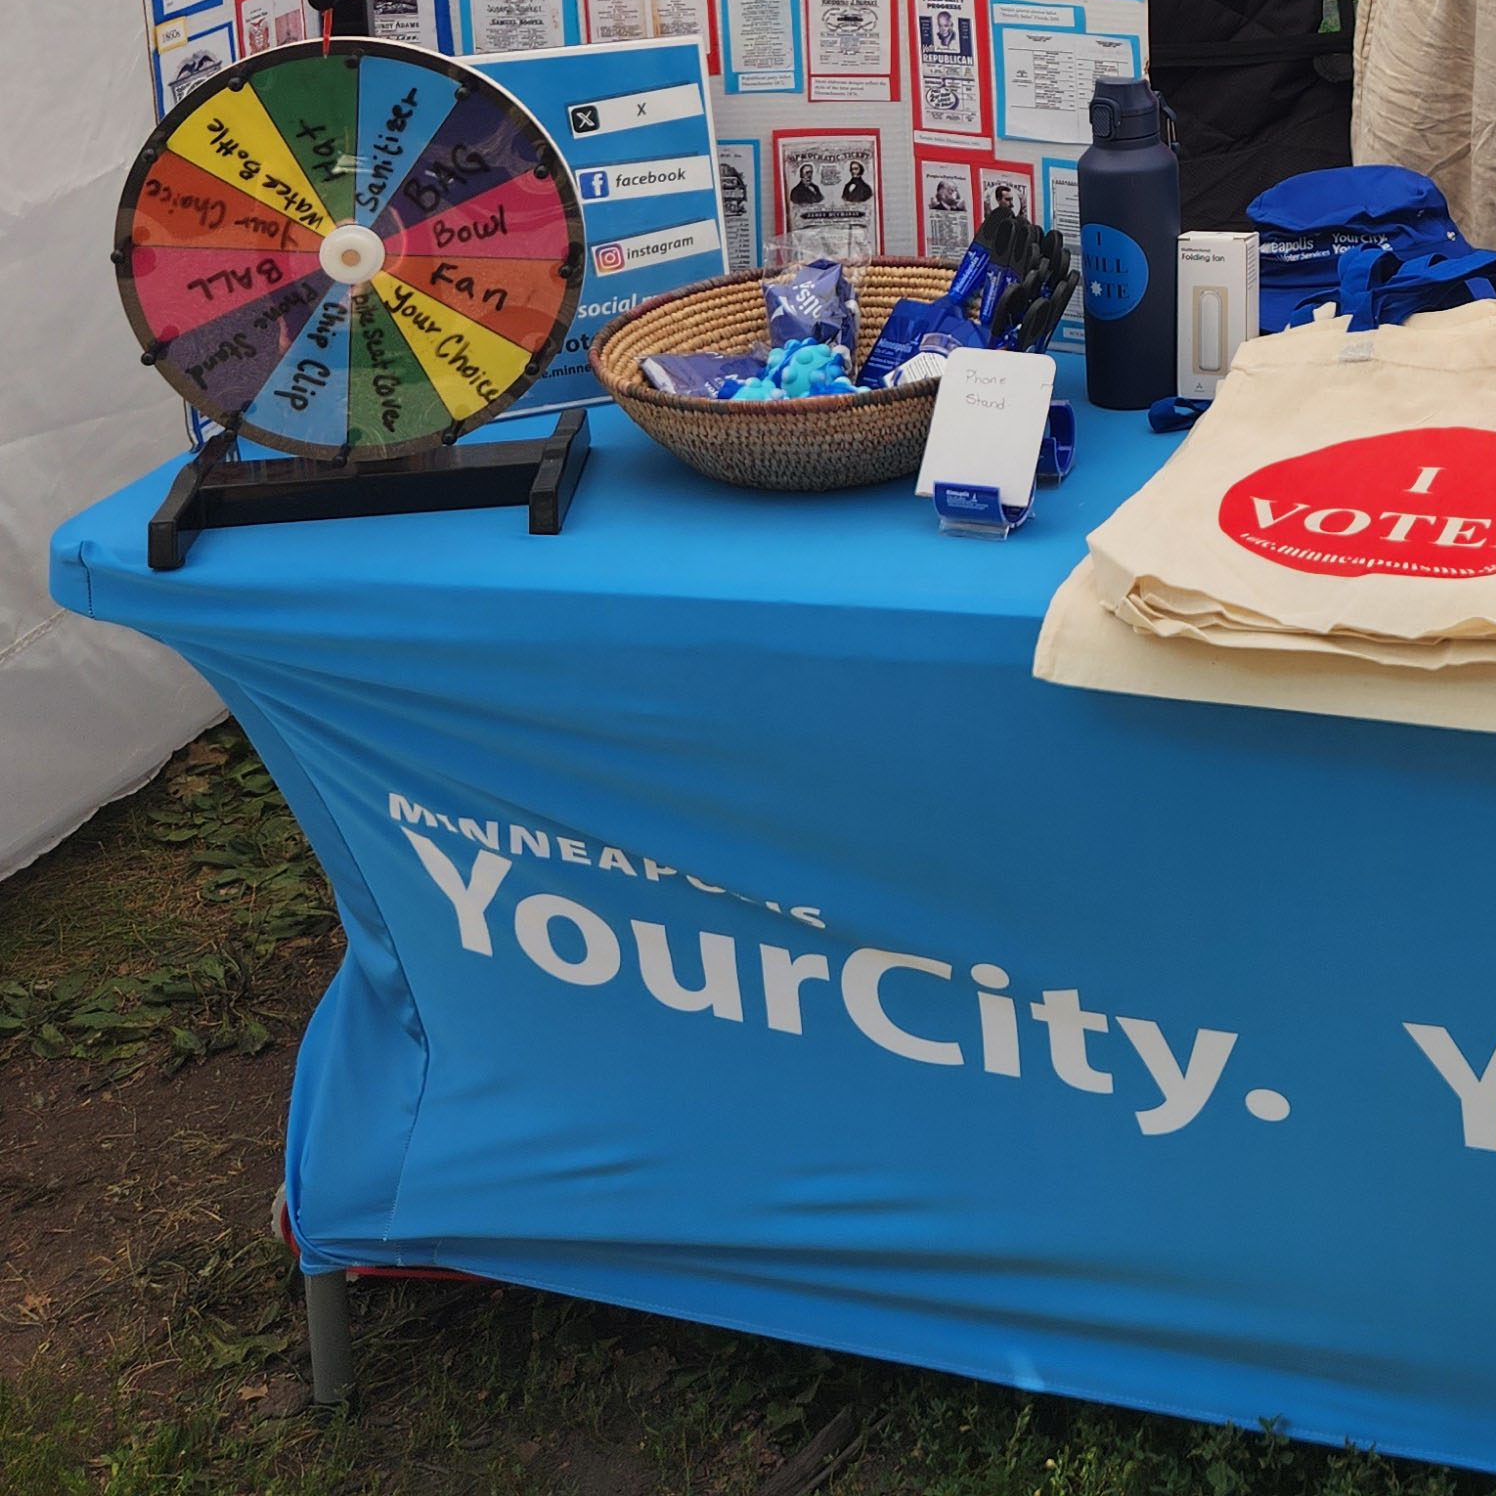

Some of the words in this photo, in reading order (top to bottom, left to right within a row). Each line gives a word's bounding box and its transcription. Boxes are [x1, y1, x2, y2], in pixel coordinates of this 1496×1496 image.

[927, 2, 962, 11] PROGRESS
[923, 54, 973, 65] REPUBLICAN
[636, 103, 647, 116] X
[205, 115, 262, 182] Bottle
[296, 117, 348, 183] Hat
[404, 141, 492, 211] BAG
[615, 167, 687, 188] facebook
[144, 178, 227, 231] Choice
[432, 205, 509, 250] Bowl
[1097, 231, 1101, 246] I
[1260, 237, 1314, 253] eapolis
[626, 234, 695, 260] instagram
[1181, 252, 1211, 263] Folding
[1212, 253, 1226, 262] fan
[1301, 249, 1331, 260] Services
[185, 257, 285, 303] BALL
[429, 261, 509, 312] Fan
[1085, 282, 1130, 299] TE
[252, 281, 319, 332] Phone
[577, 293, 637, 319] social
[306, 301, 348, 350] Chip
[184, 332, 258, 392] Stand
[434, 334, 502, 406] Choice
[965, 369, 1007, 385] Phone
[273, 358, 332, 412] Clip
[965, 393, 1006, 410] Stand
[1402, 466, 1447, 495] I
[387, 790, 827, 930] MINNEAPIS
[400, 825, 1291, 1137] YourCity.
